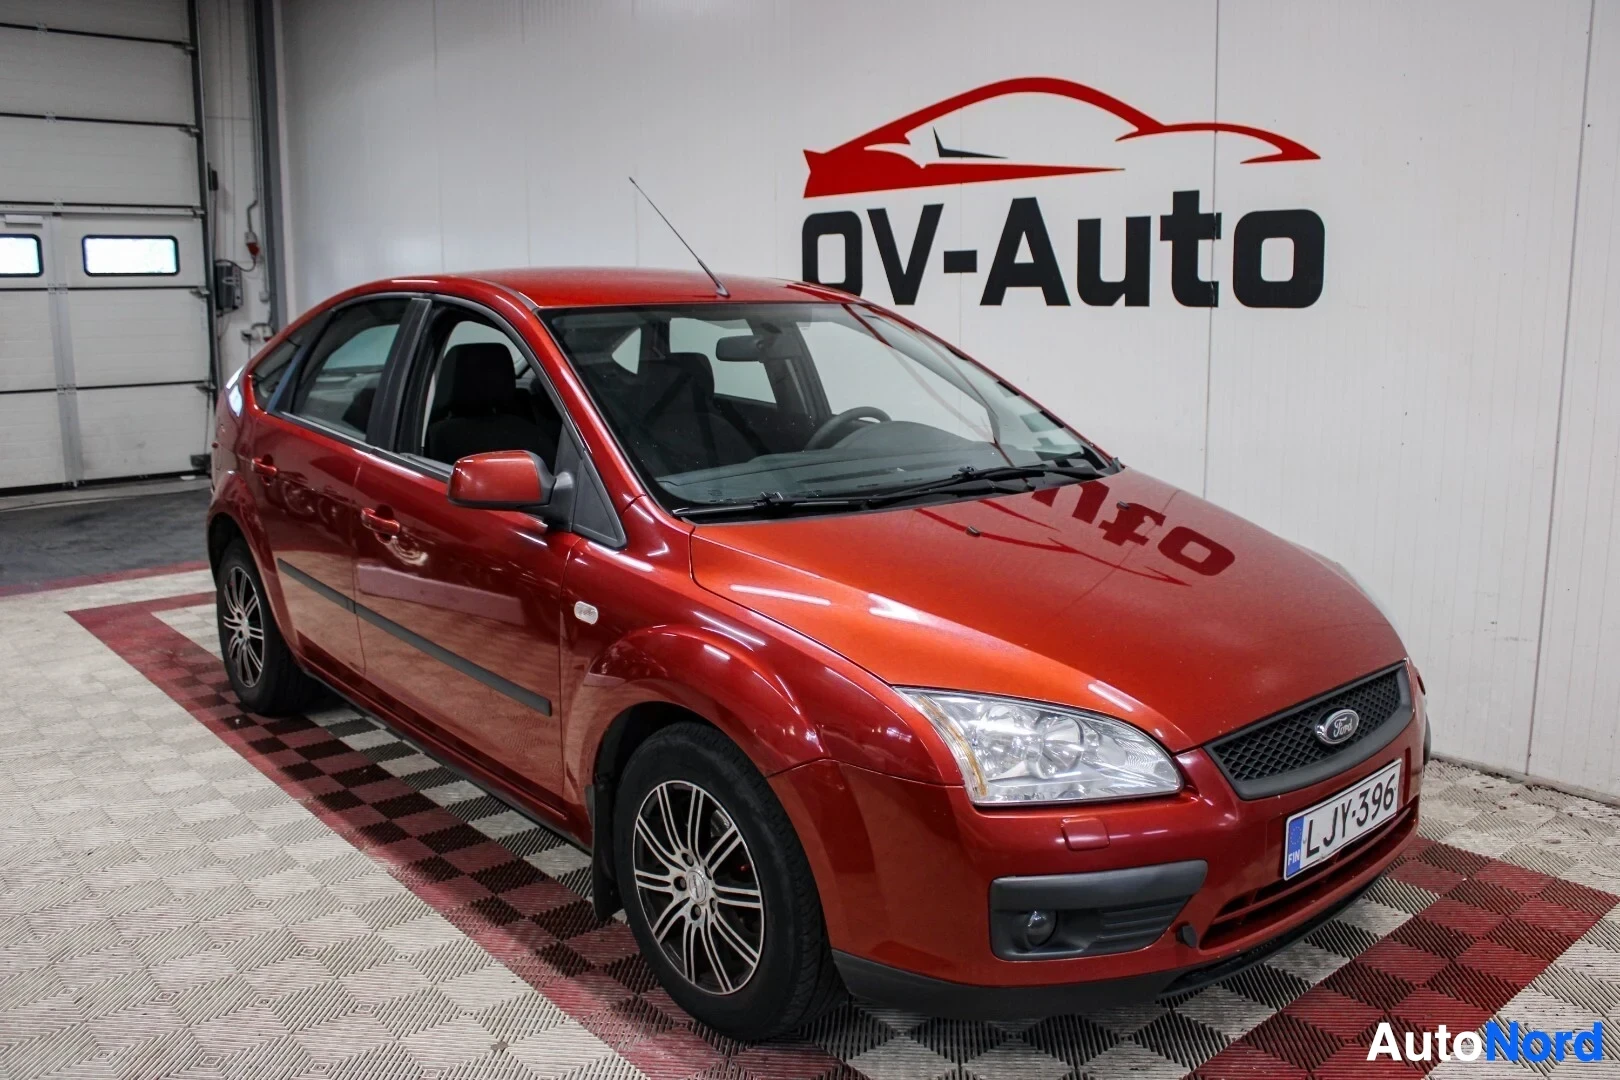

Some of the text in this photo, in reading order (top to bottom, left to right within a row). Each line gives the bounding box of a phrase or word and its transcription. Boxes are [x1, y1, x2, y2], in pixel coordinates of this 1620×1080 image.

[802, 189, 1326, 308] OV-Auto
[1333, 716, 1353, 738] Ford
[1306, 773, 1396, 858] LJY-396
[1287, 848, 1301, 866] FIN
